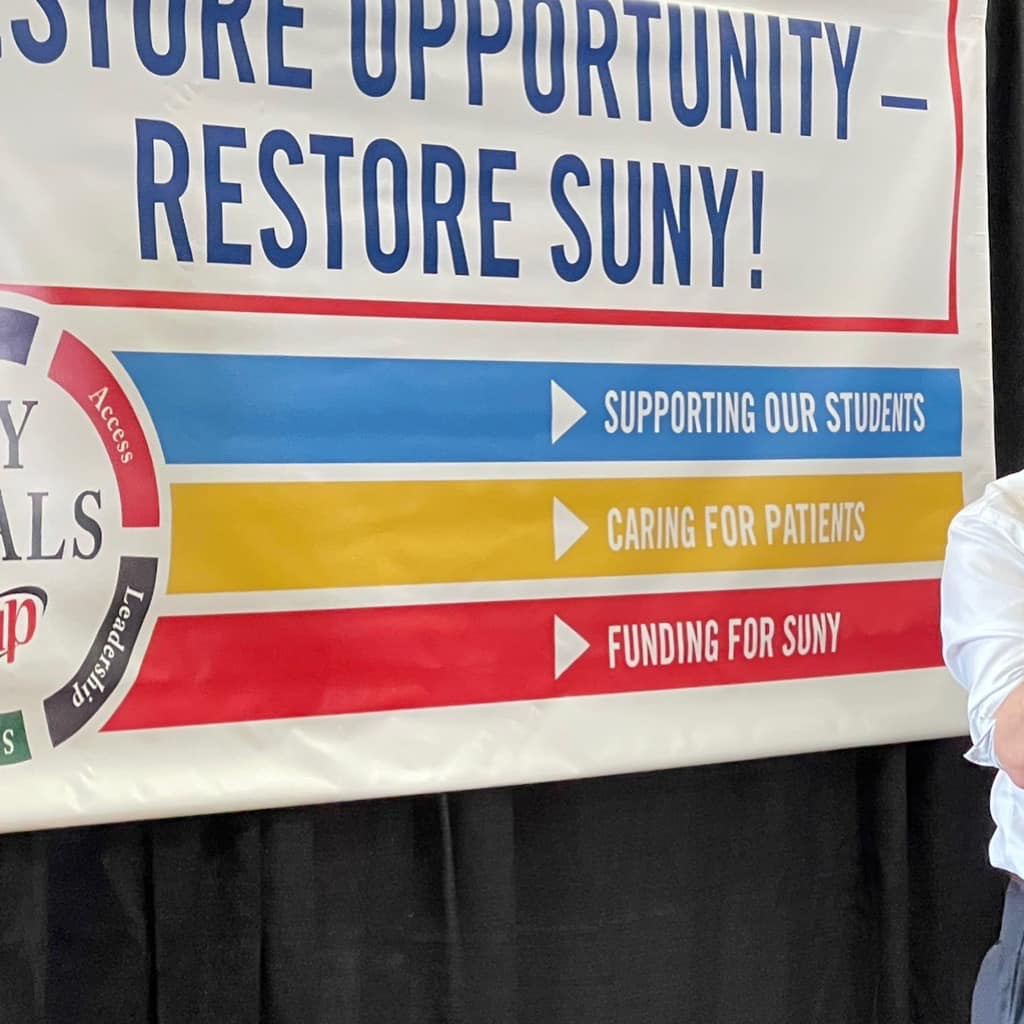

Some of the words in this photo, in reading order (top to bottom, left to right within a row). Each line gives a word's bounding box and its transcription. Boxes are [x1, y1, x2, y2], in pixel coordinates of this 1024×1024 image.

[351, 0, 862, 141] OPPORTUNITY
[135, 118, 520, 278] RESTORE
[550, 153, 765, 289] SUNY!
[88, 385, 133, 465] Access
[604, 389, 755, 434] SUPPORTING
[765, 391, 817, 434] OUR
[826, 392, 925, 433] STUDENTS
[607, 506, 695, 551] CARING
[705, 504, 757, 547] FOR
[767, 501, 865, 545] PATIENTS
[72, 585, 144, 708] Leadership
[608, 618, 718, 669] FUNDING
[728, 616, 773, 660] FOR
[782, 612, 841, 657] SUNY
